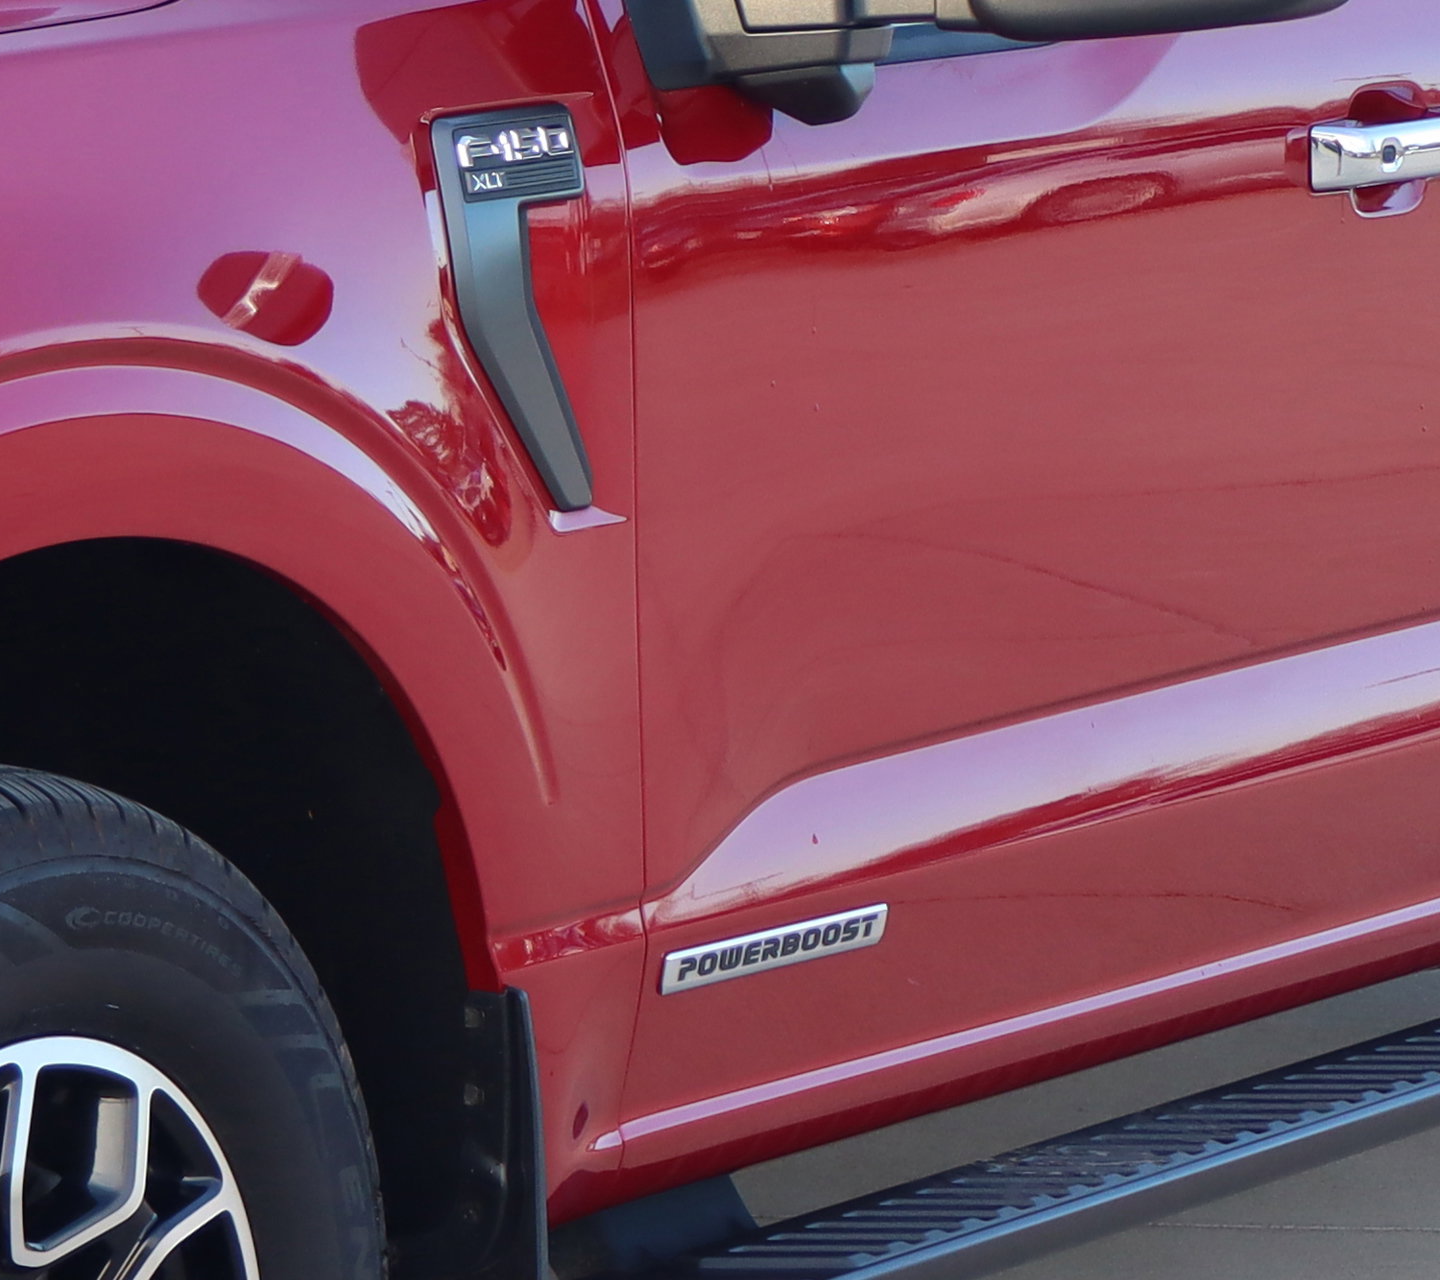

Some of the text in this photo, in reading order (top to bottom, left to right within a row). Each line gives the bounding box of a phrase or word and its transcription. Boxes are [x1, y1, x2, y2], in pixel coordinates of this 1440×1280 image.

[456, 125, 574, 169] F-150
[472, 171, 506, 192] XLT
[677, 914, 879, 982] POWERBOOST
